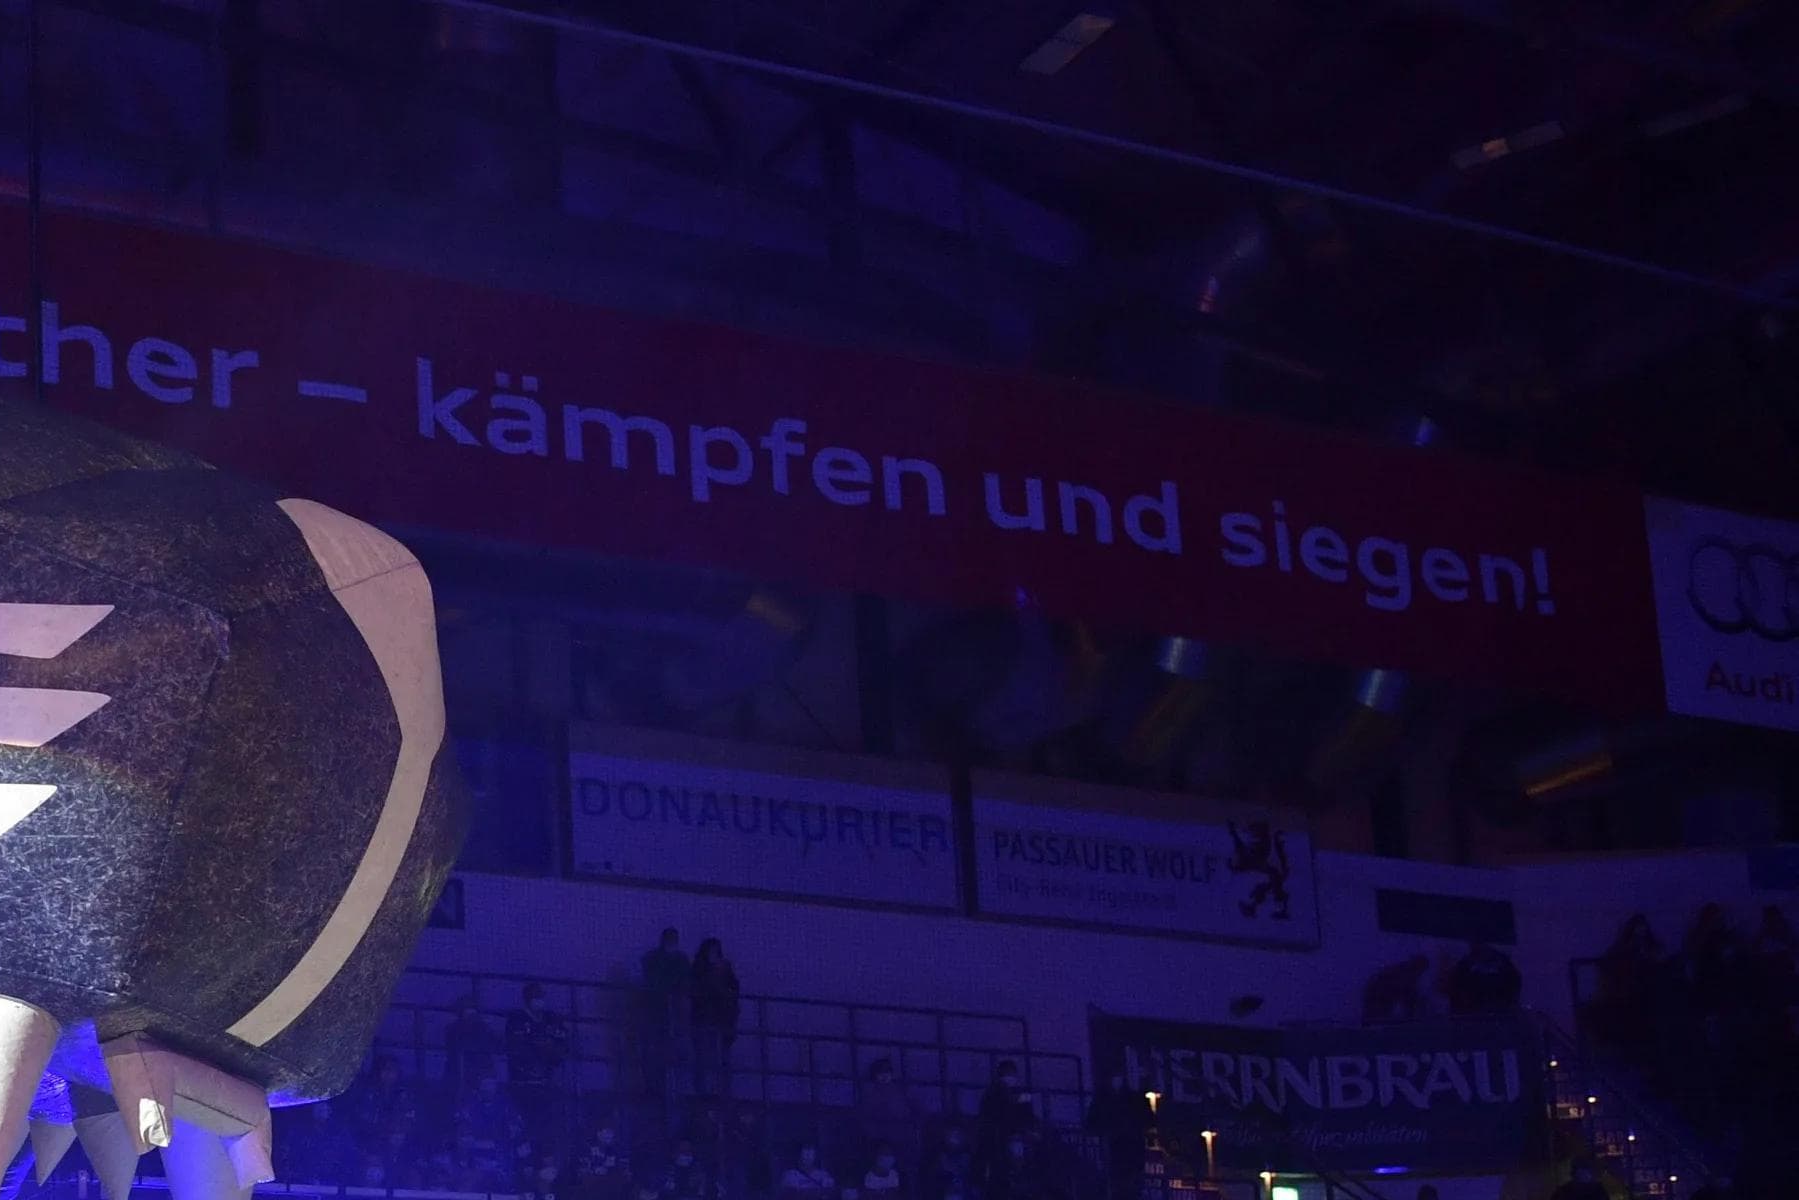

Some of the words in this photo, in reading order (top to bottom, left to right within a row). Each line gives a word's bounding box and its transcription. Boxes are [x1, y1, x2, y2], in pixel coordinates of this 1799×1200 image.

[416, 355, 948, 517] kämpfen
[982, 471, 1185, 557] und
[1219, 499, 1558, 617] siegen!
[1705, 660, 1794, 704] Audi
[578, 776, 949, 853] DONAUKURIER
[993, 830, 1137, 874] PASSAUER
[1143, 847, 1216, 884] WOLF
